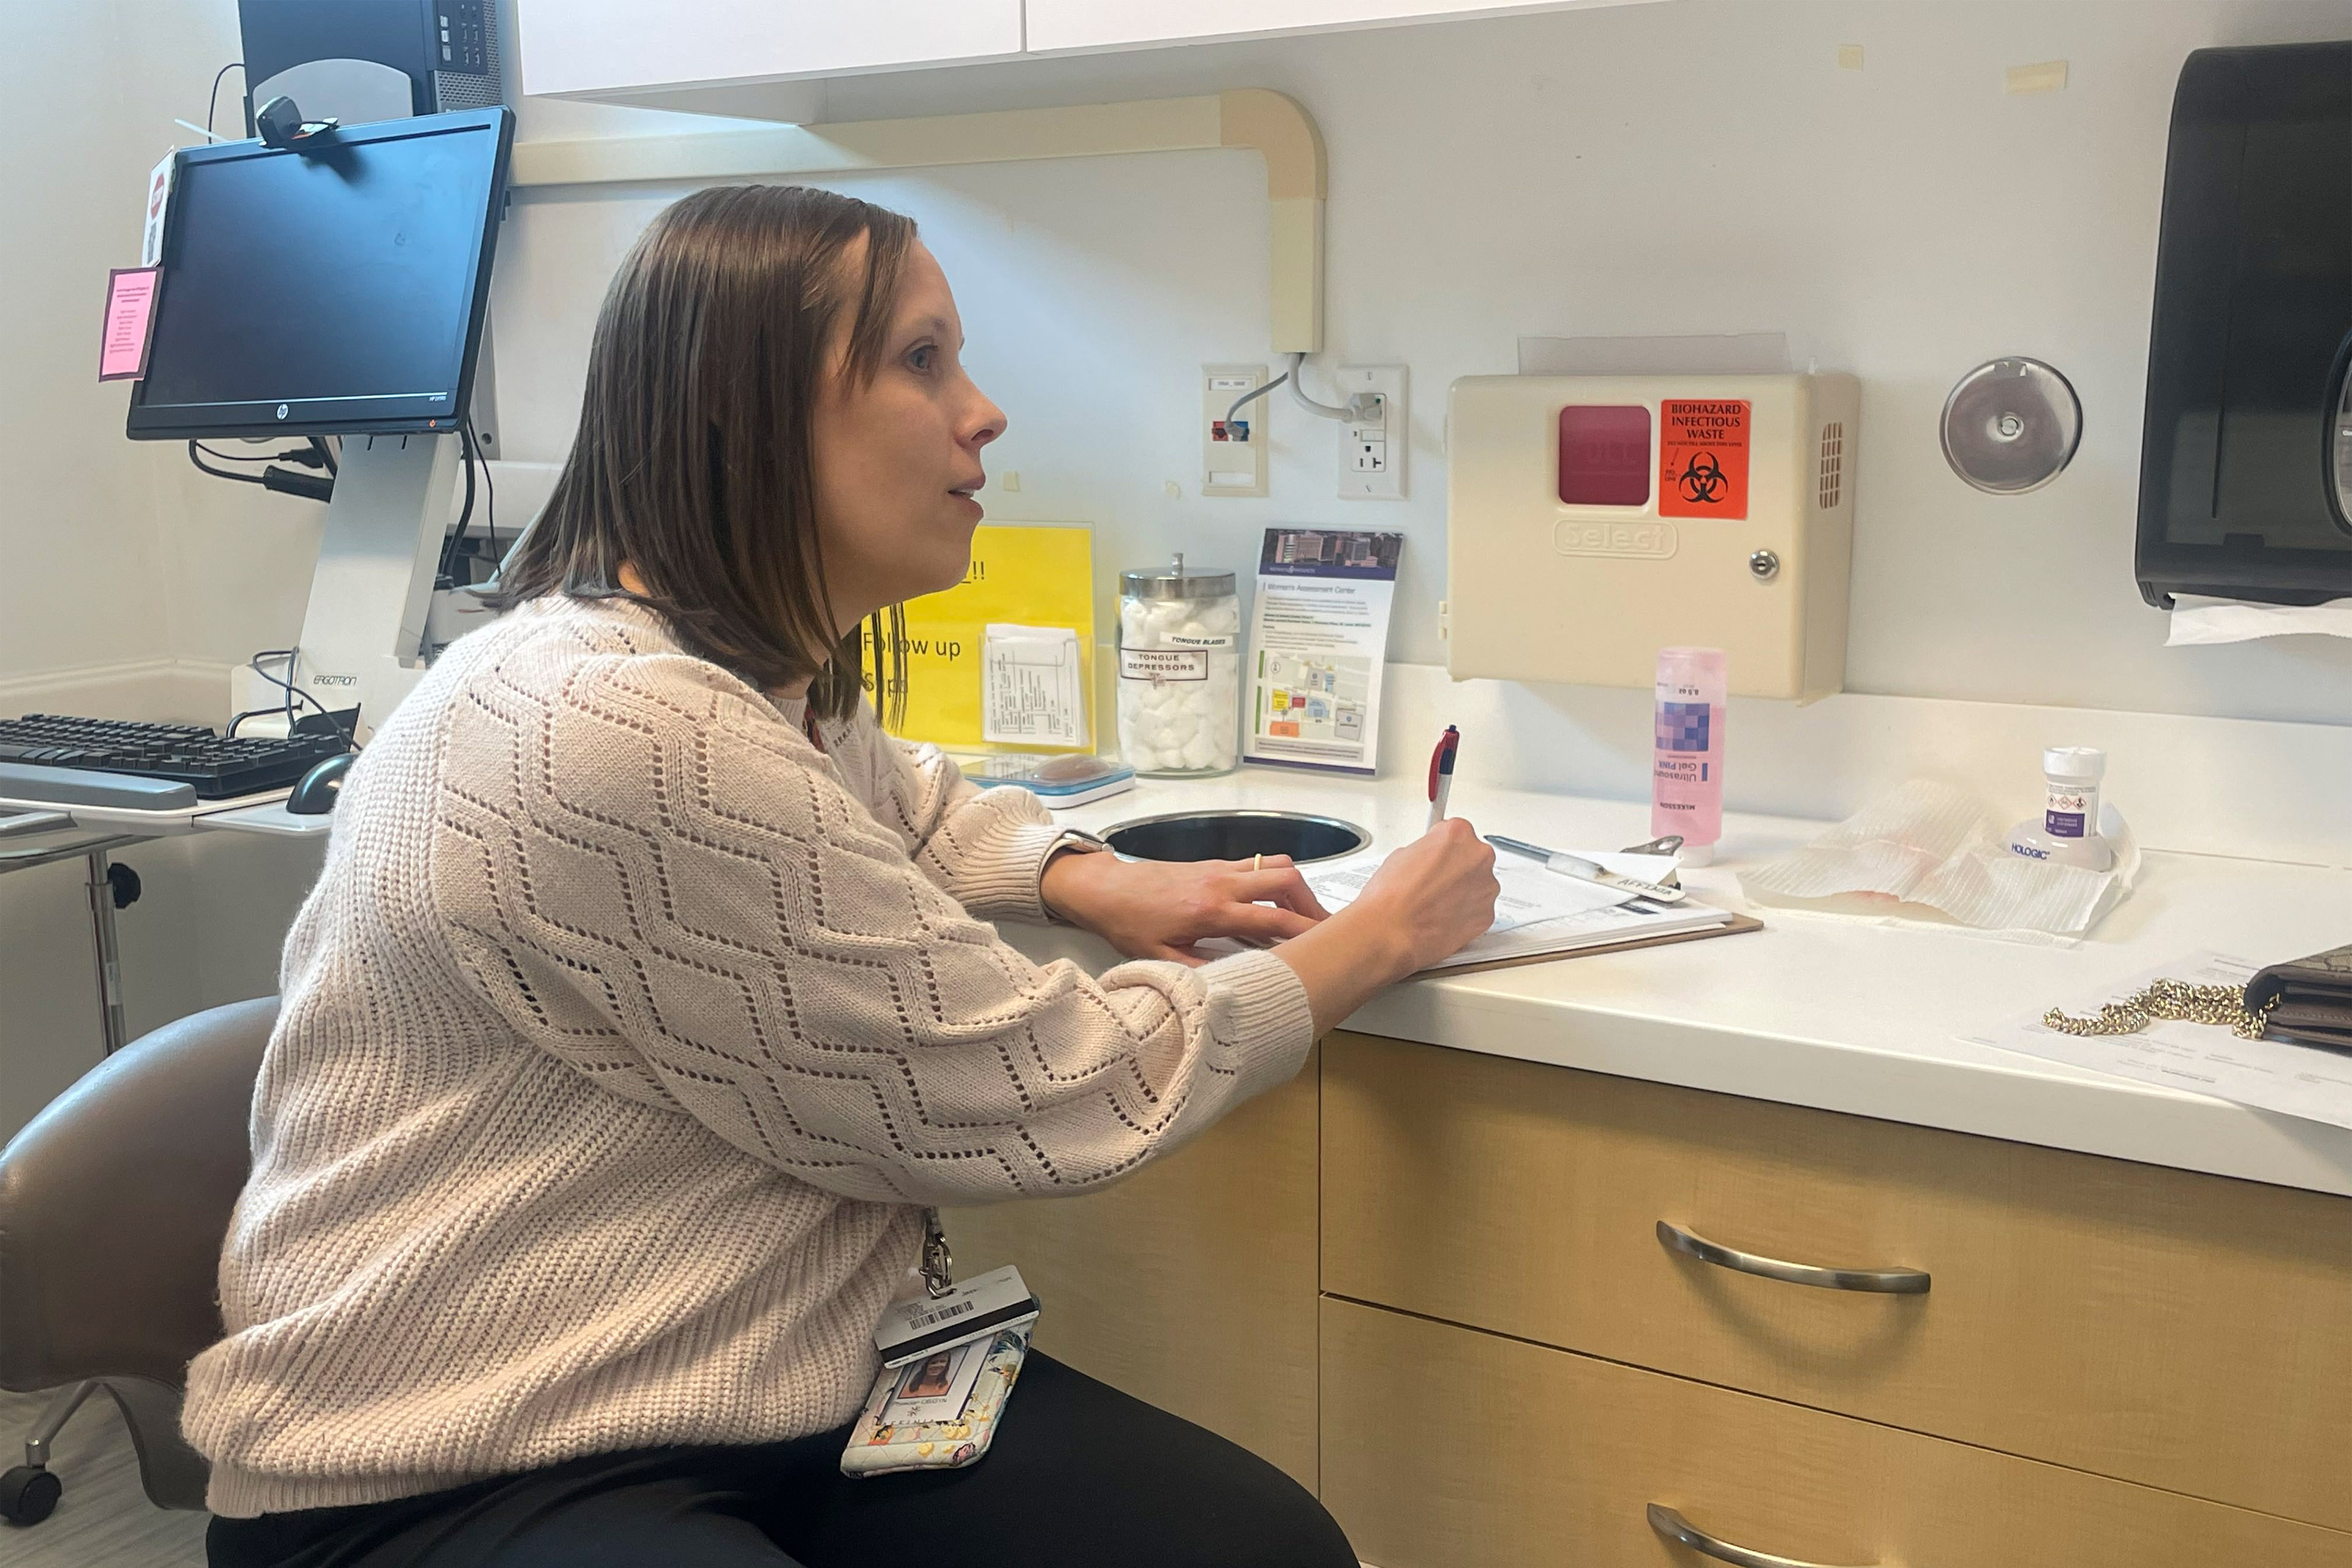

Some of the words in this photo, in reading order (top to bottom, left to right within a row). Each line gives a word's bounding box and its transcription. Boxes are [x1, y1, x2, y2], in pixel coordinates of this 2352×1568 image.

[1672, 404, 1741, 415] BIOHAZARD
[1672, 417, 1740, 427] INFECTIOUS
[1687, 429, 1724, 439] WASTE
[1564, 523, 1665, 549] Select
[1172, 636, 1201, 645] TONGUE
[863, 632, 929, 654] Flow
[935, 641, 960, 662] up
[314, 675, 357, 686] ERGOTRON
[1679, 763, 1697, 772] Gel
